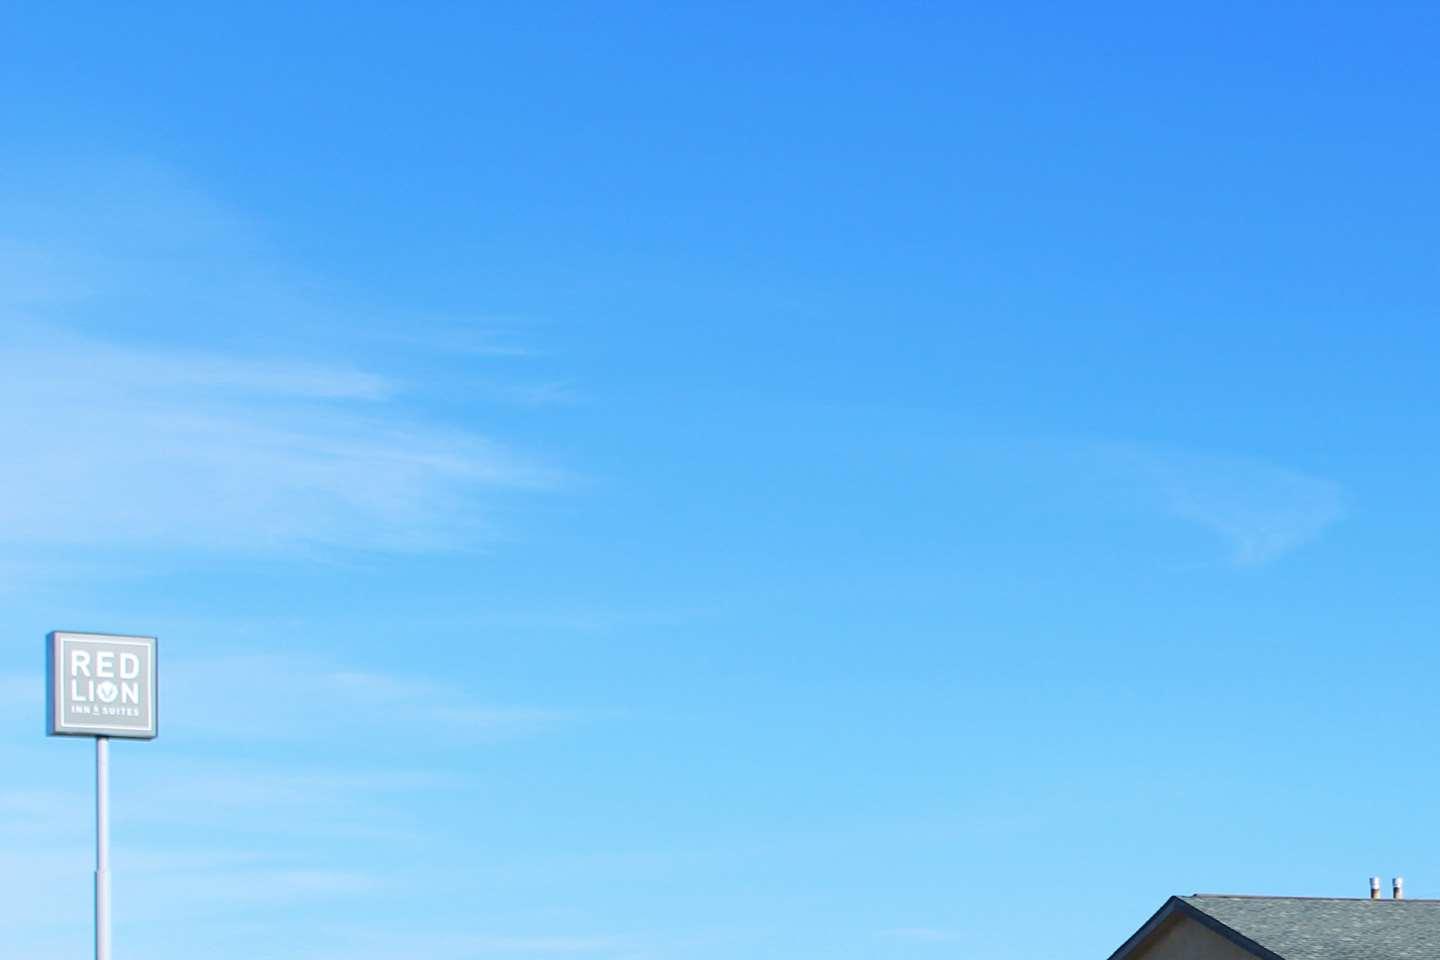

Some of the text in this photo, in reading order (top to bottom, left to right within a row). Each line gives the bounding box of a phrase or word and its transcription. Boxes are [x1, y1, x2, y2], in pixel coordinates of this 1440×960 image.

[71, 649, 139, 679] RED
[71, 679, 139, 704] LION
[71, 704, 90, 713] INN
[102, 706, 139, 716] SUITES
